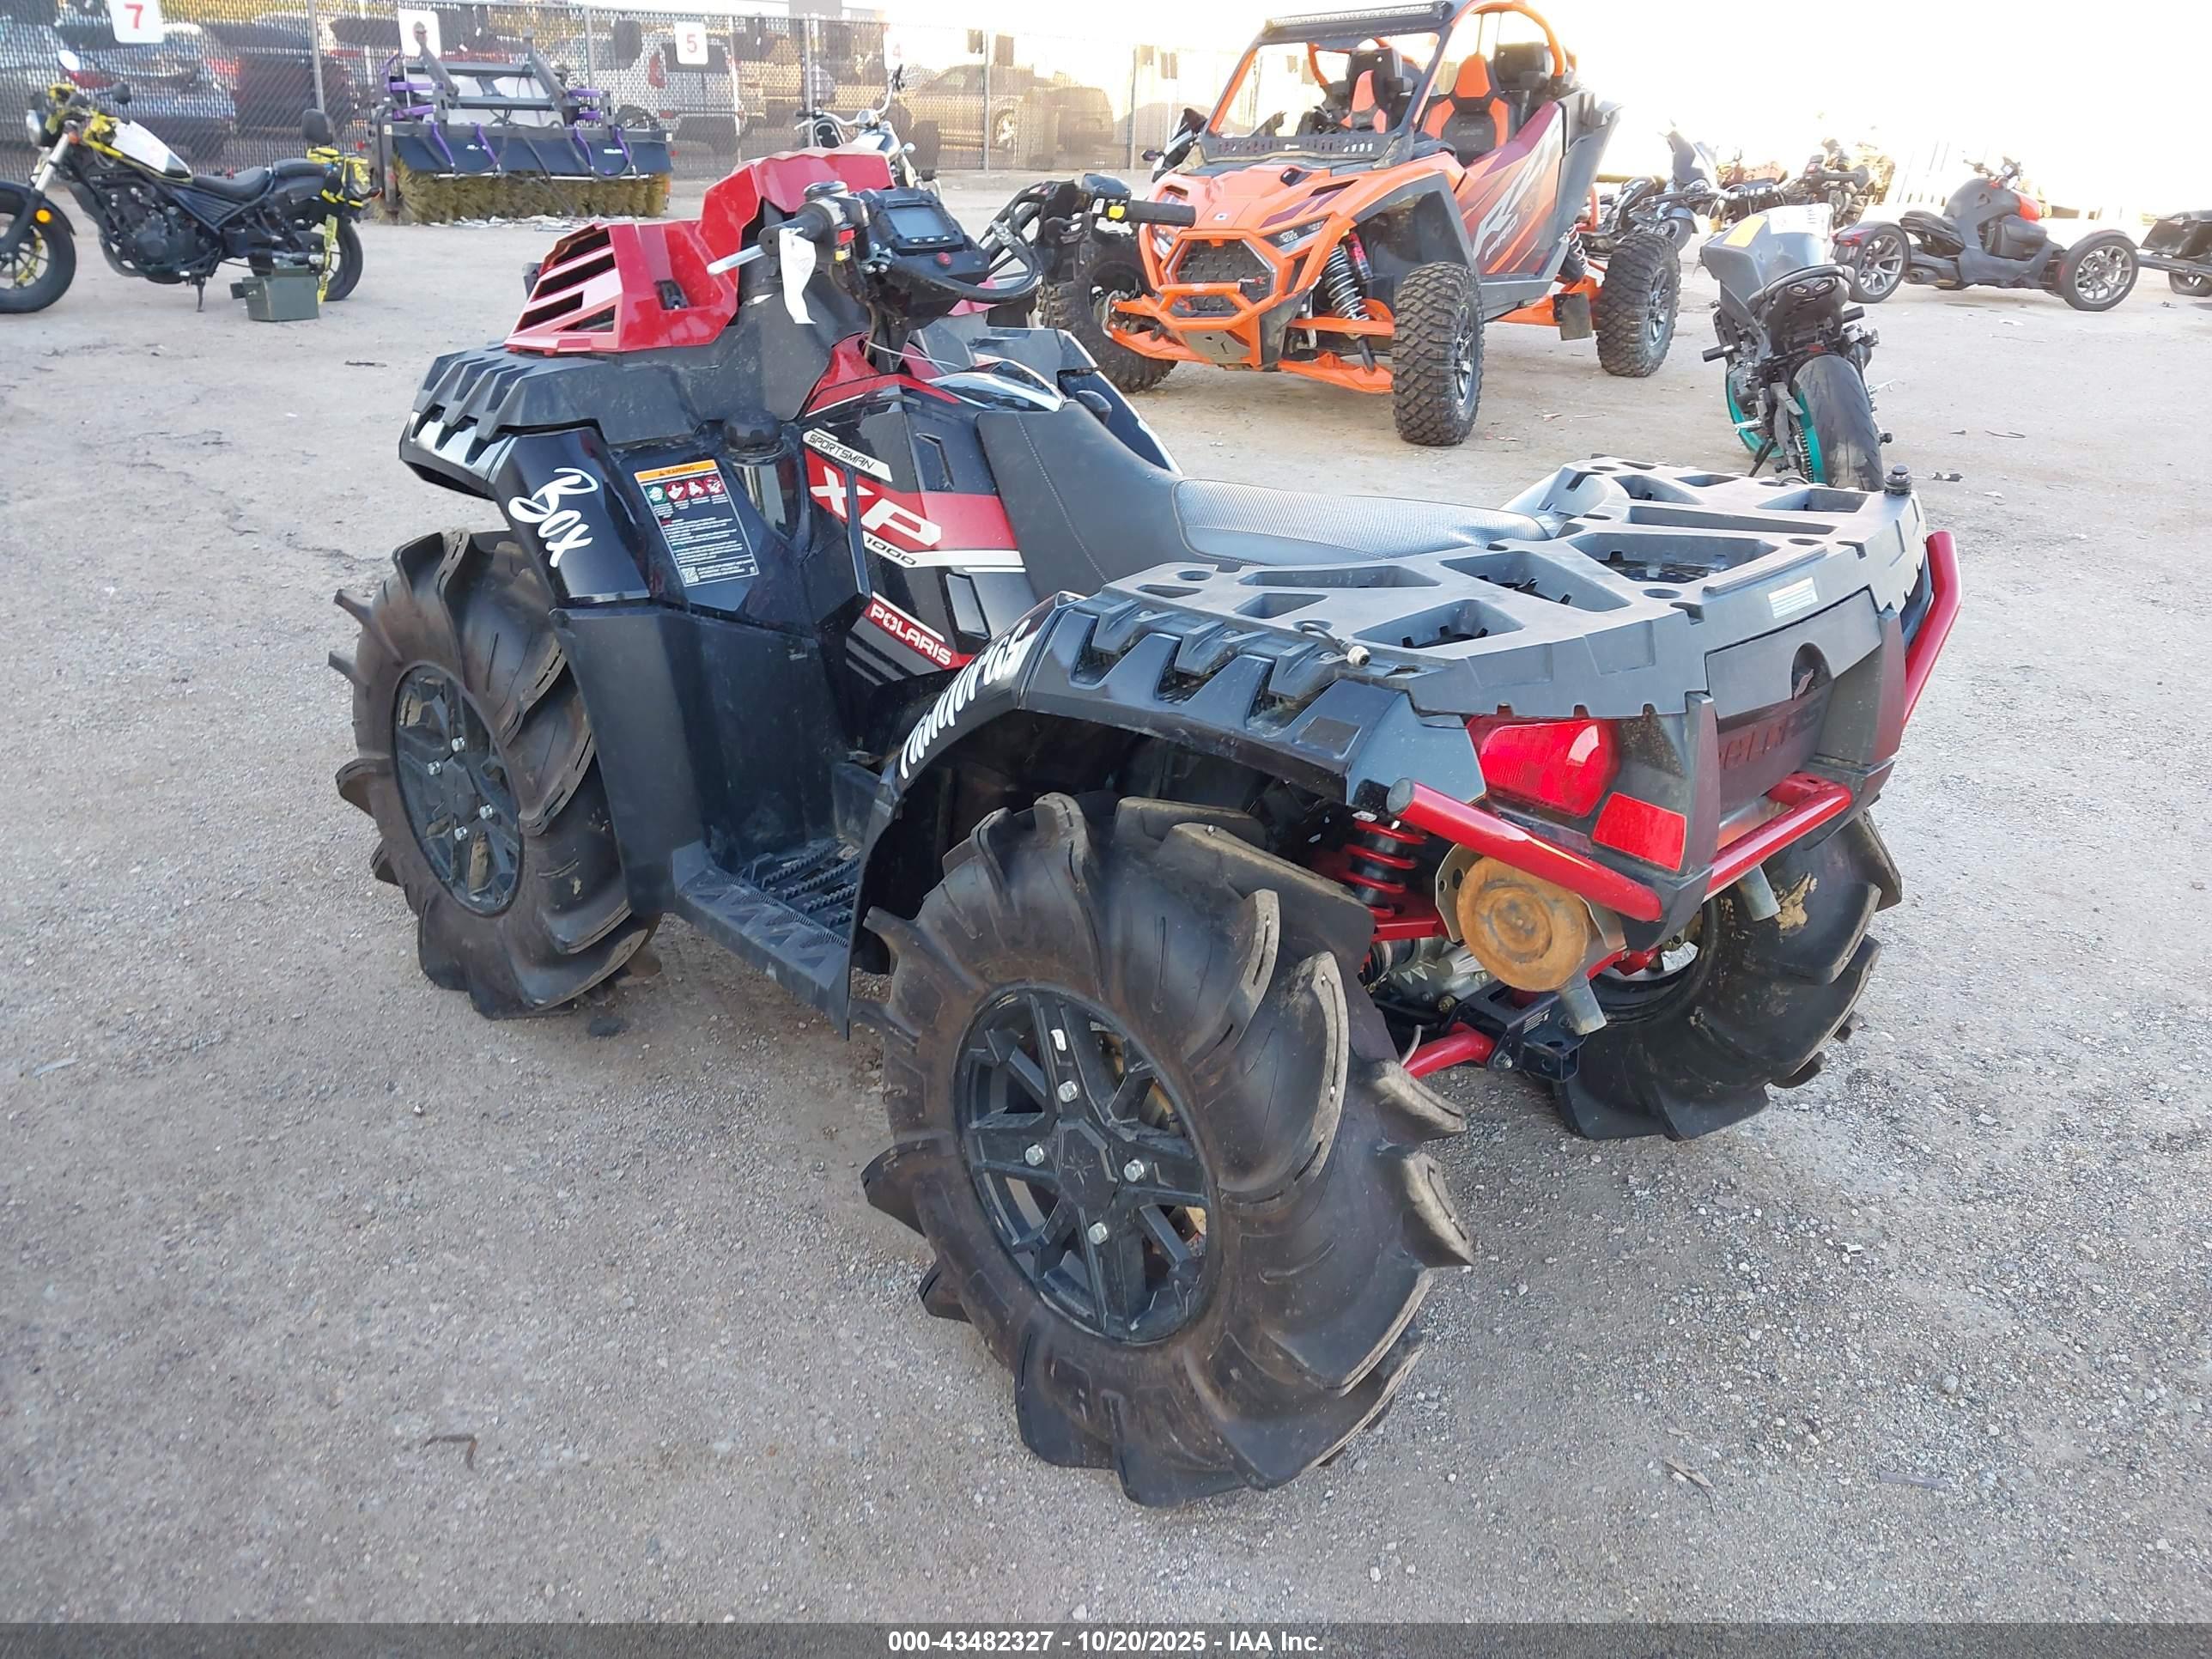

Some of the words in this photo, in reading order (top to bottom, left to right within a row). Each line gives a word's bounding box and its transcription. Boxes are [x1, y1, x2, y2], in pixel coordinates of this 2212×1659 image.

[124, 3, 143, 29] 7
[686, 33, 697, 53] 5
[808, 433, 874, 471] SPORTSMAN
[810, 466, 941, 547] XP
[866, 536, 917, 567] 1000
[869, 603, 953, 666] POLARIS
